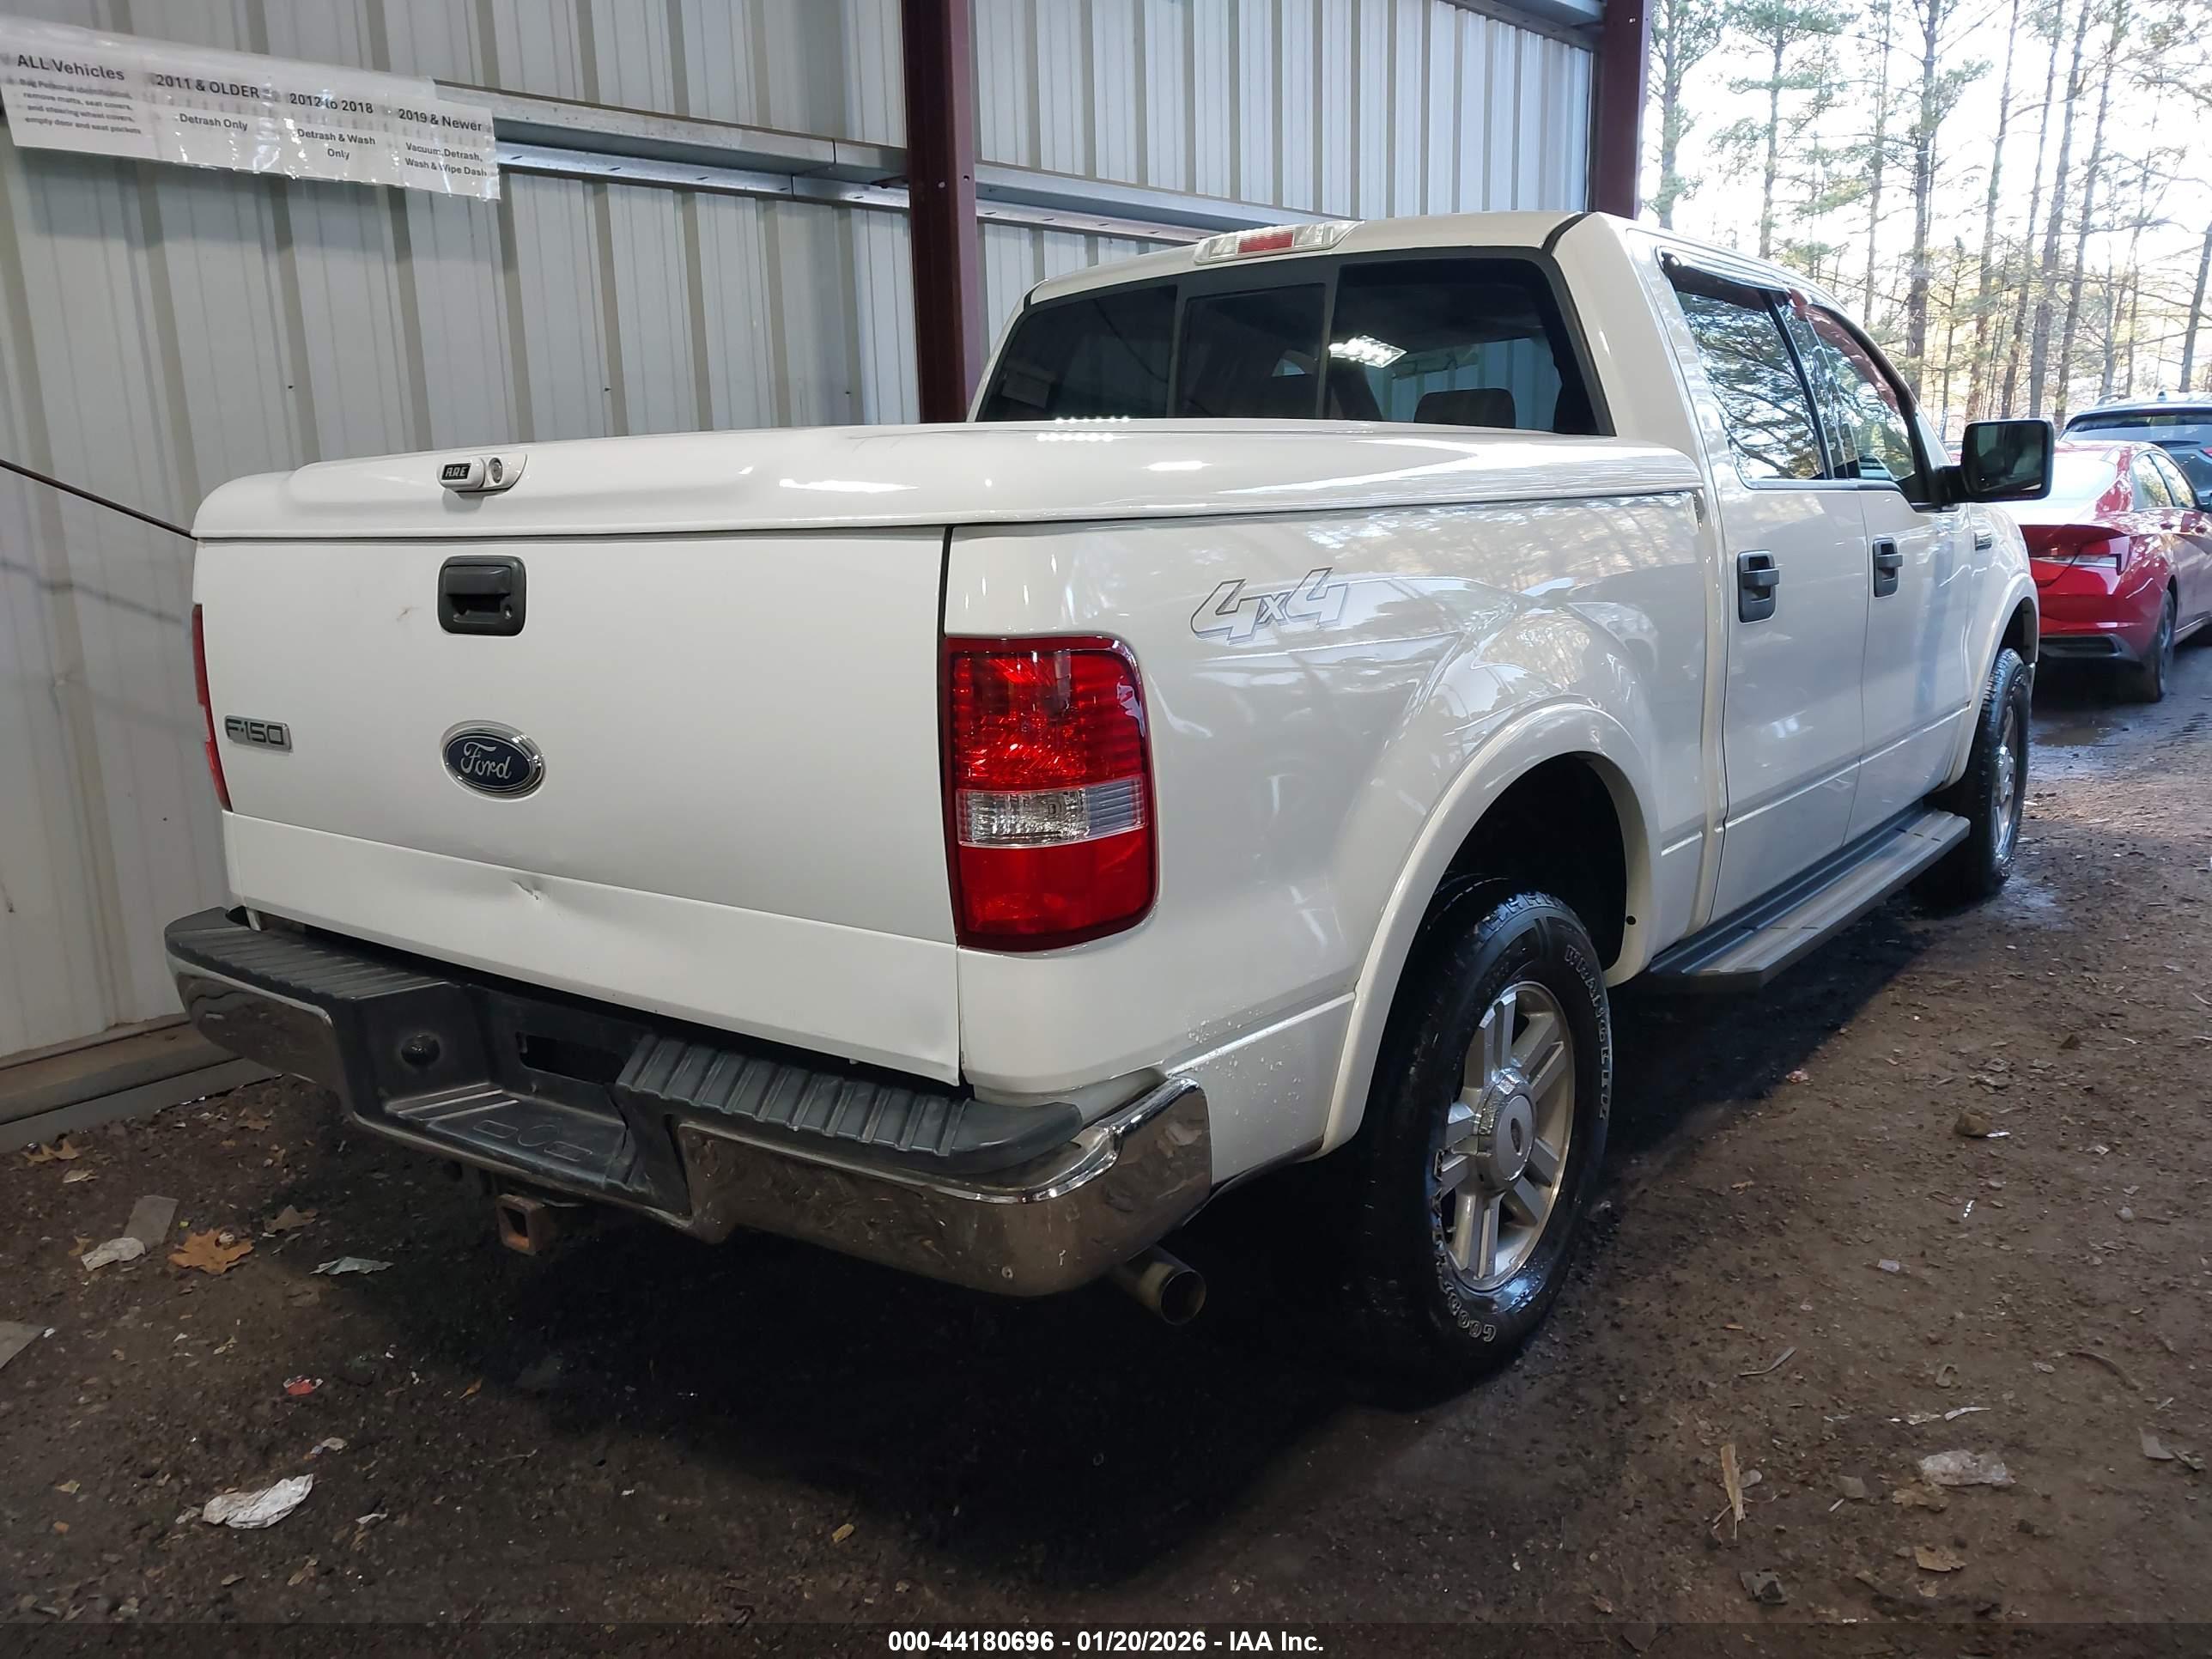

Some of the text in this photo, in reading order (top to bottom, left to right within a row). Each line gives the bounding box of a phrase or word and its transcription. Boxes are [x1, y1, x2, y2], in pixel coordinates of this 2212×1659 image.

[17, 54, 125, 81] ALL Vehicles
[156, 74, 260, 99] 2011 & OLDER
[289, 93, 374, 113] 2012 to 2018
[179, 112, 248, 131] Detrash Only
[398, 108, 483, 131] 2019 & Newer
[296, 128, 376, 145] Detrash & Wash
[327, 148, 350, 161] Only
[404, 157, 488, 177] Wash & Wipe Dash
[445, 466, 468, 477] ARE
[1191, 567, 1348, 646] 4x4
[225, 718, 285, 745] F-150
[460, 741, 512, 781] Ford
